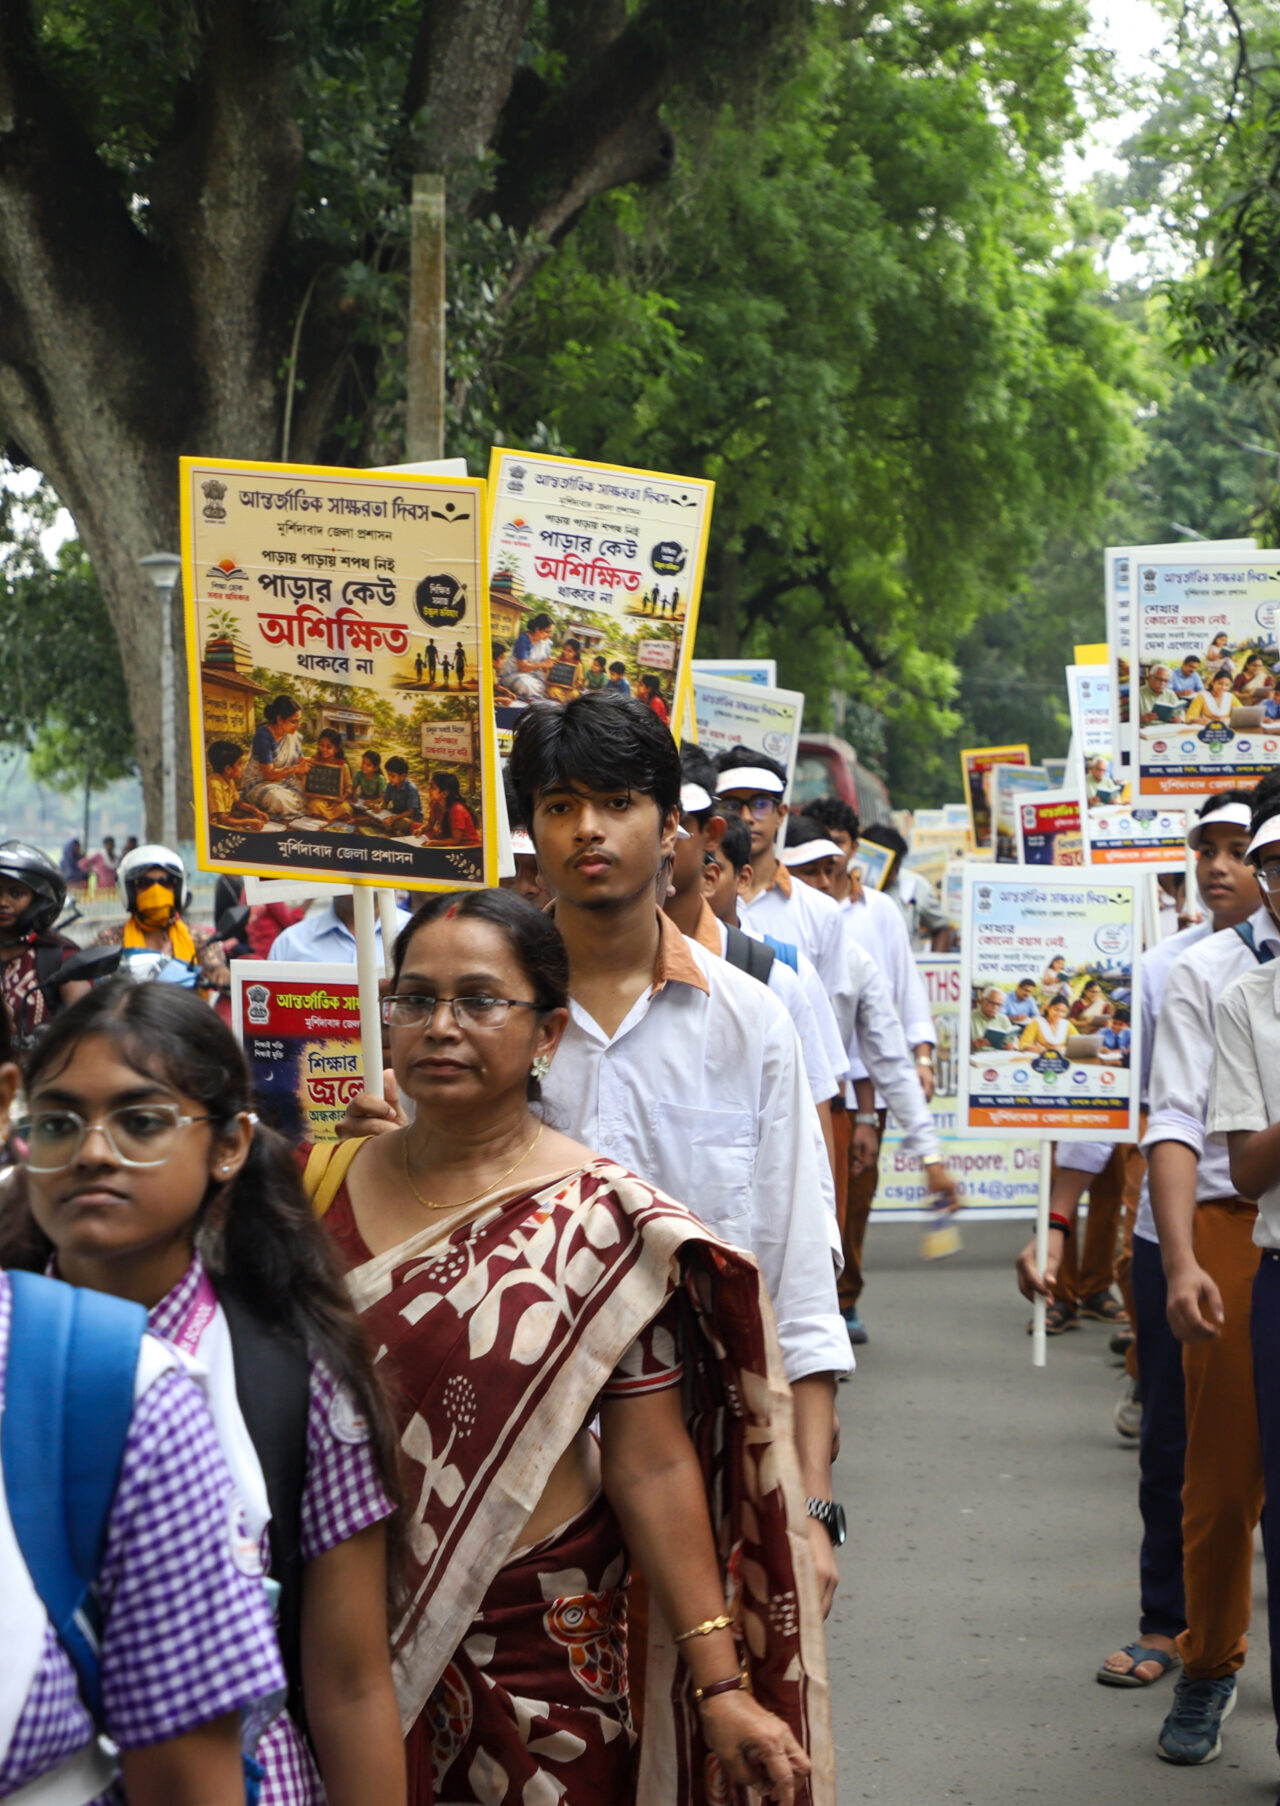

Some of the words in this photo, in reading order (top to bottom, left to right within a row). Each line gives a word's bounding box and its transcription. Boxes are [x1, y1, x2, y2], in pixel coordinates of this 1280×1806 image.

[239, 488, 323, 513] আন্তর্জাতিক
[327, 496, 388, 519] সাক্ষরতা
[392, 496, 430, 522] দিবস
[276, 520, 324, 537] মুর্শিদাবাদ
[327, 526, 354, 539] জেলা
[356, 528, 392, 542] প্রশাসন
[539, 530, 593, 554] পাড়ার
[600, 538, 638, 559] কেউ
[260, 550, 297, 566] পাড়ায়
[300, 552, 336, 568] পাড়ায়
[340, 554, 370, 570] শপথ
[374, 556, 396, 573] নিই
[534, 552, 642, 592] অশিক্ষিত
[258, 574, 333, 605] পাড়ার
[342, 574, 397, 606] কেউ
[600, 592, 614, 606] না
[256, 603, 410, 655] অশিক্ষিত
[296, 652, 349, 674] থাকবে
[356, 658, 374, 675] না
[276, 838, 333, 858] মুর্শিদাবাদ
[336, 846, 368, 862] জেলা
[370, 850, 414, 864] প্রশাসন
[276, 990, 340, 1010] আন্তর্জাতিক
[308, 1051, 358, 1074] শিক্ষার
